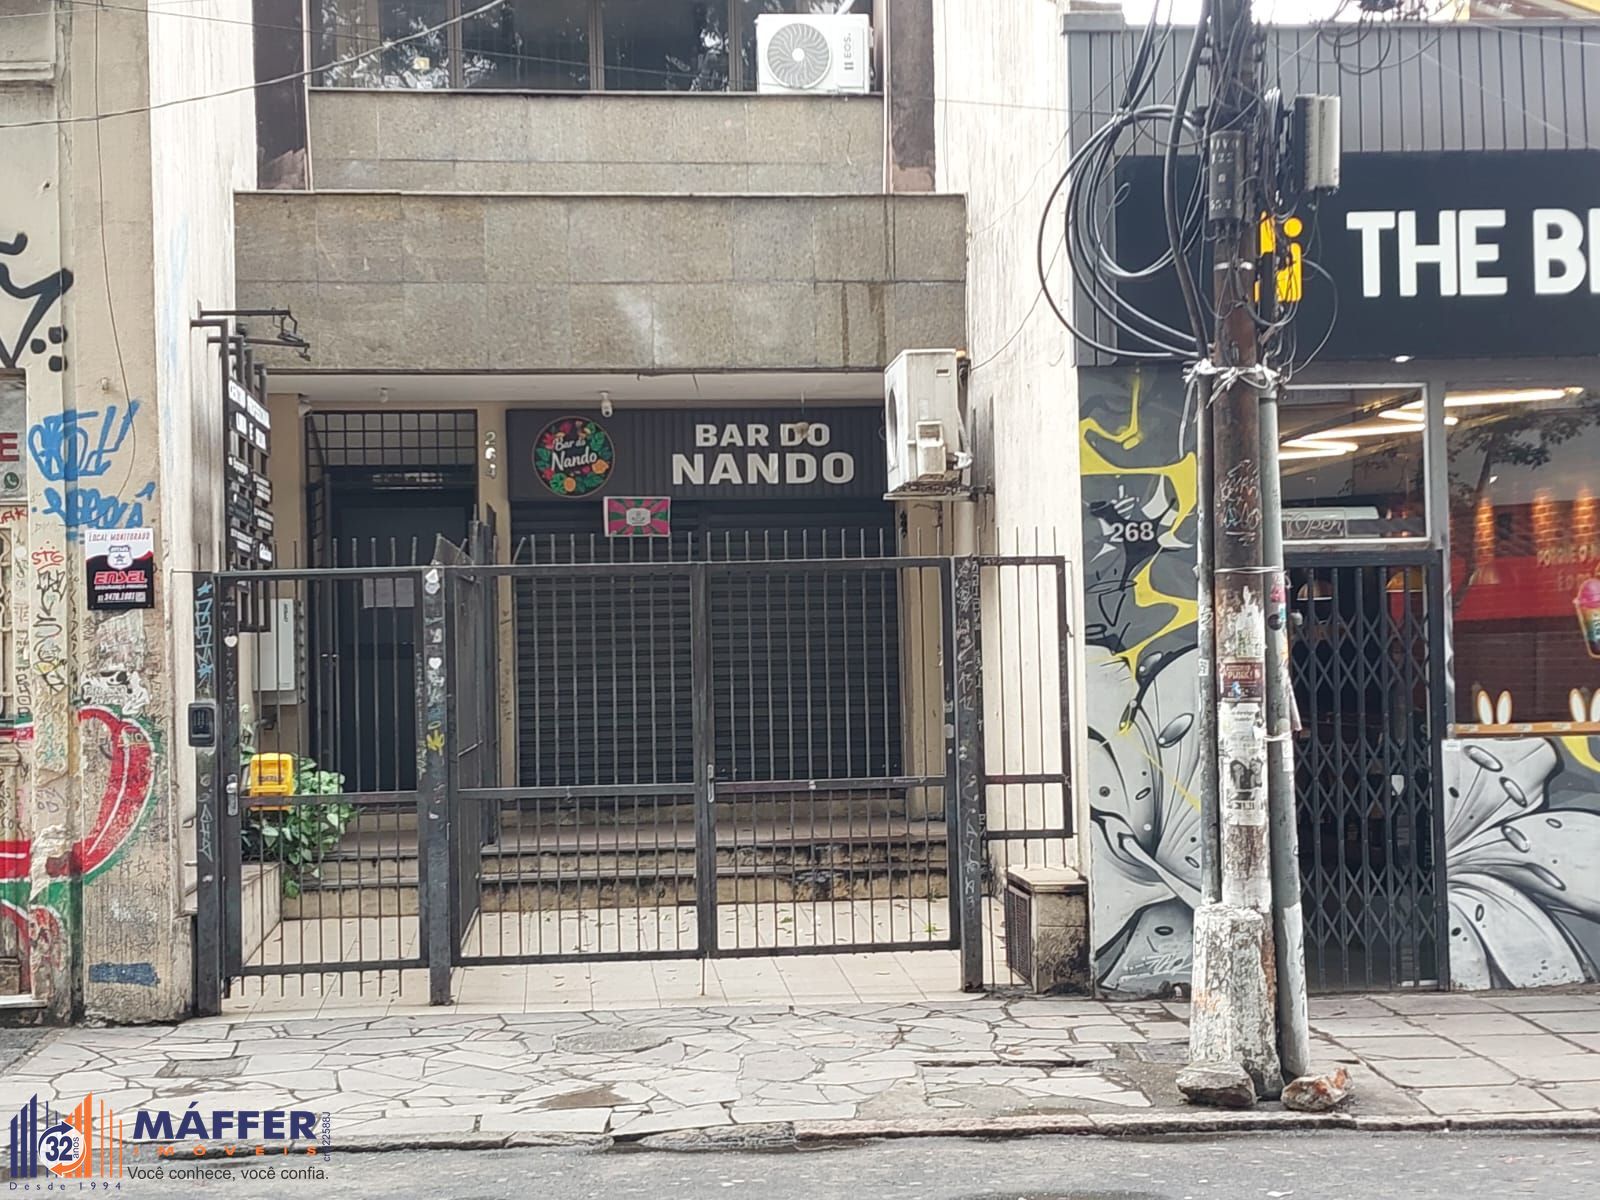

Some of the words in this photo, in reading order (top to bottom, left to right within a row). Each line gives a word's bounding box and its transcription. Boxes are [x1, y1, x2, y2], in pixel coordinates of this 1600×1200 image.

[1346, 209, 1508, 297] THE
[1533, 208, 1600, 295] B
[553, 436, 574, 452] Bar
[695, 424, 769, 447] BAR
[780, 422, 830, 447] DO
[551, 445, 598, 471] Nando
[672, 452, 855, 485] NANDO
[88, 532, 108, 542] LOCAL
[1109, 521, 1154, 542] 268
